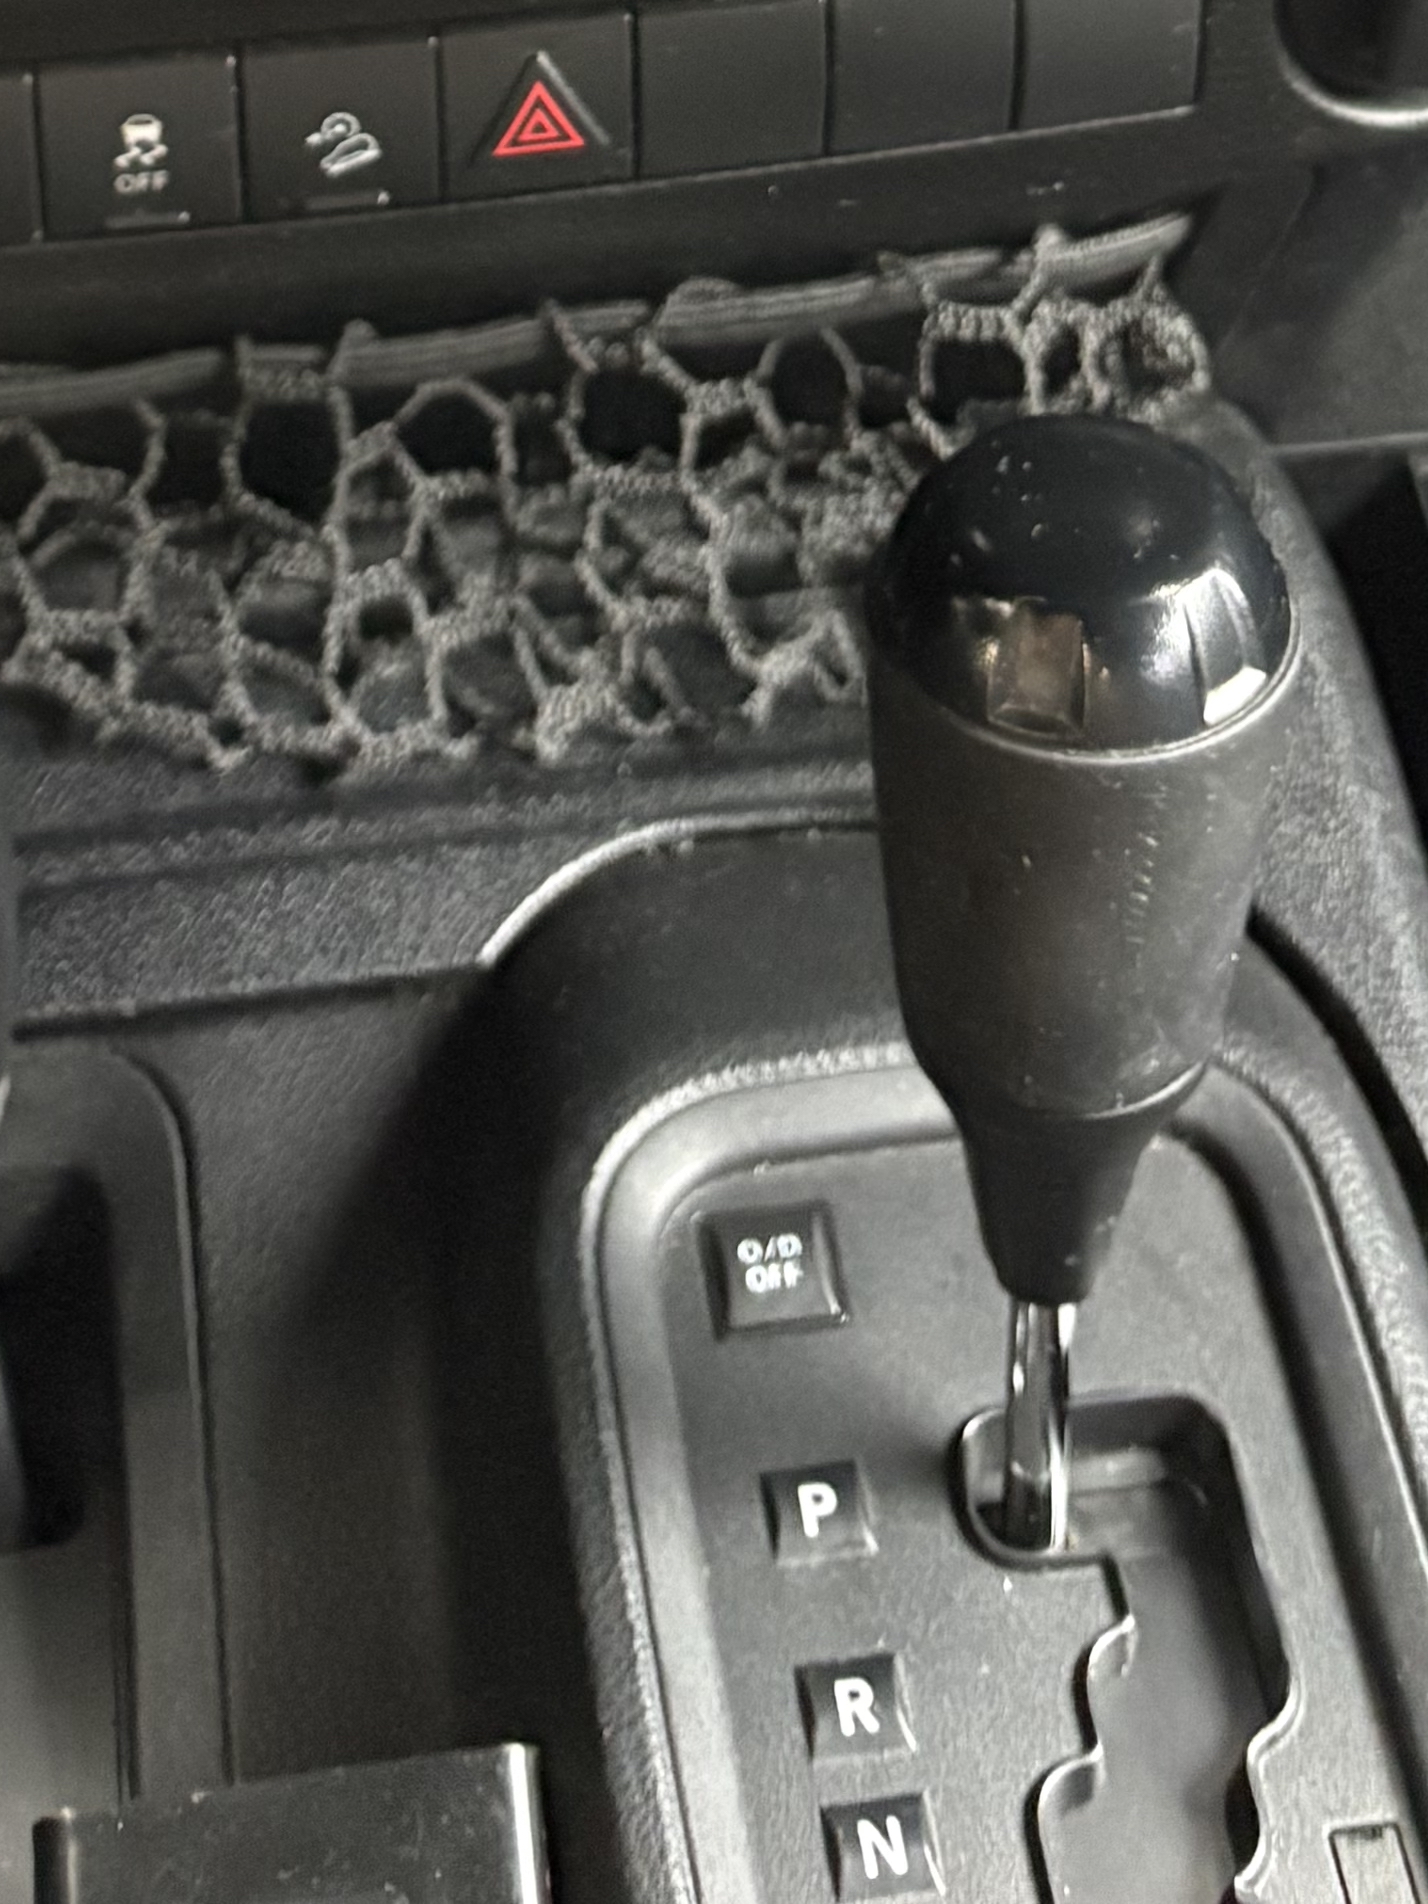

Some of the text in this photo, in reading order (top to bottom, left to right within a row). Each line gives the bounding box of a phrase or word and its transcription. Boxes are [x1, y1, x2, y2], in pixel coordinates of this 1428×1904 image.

[737, 1233, 802, 1263] O/D
[797, 1483, 837, 1537] P
[834, 1678, 879, 1735] R
[856, 1816, 908, 1879] N
